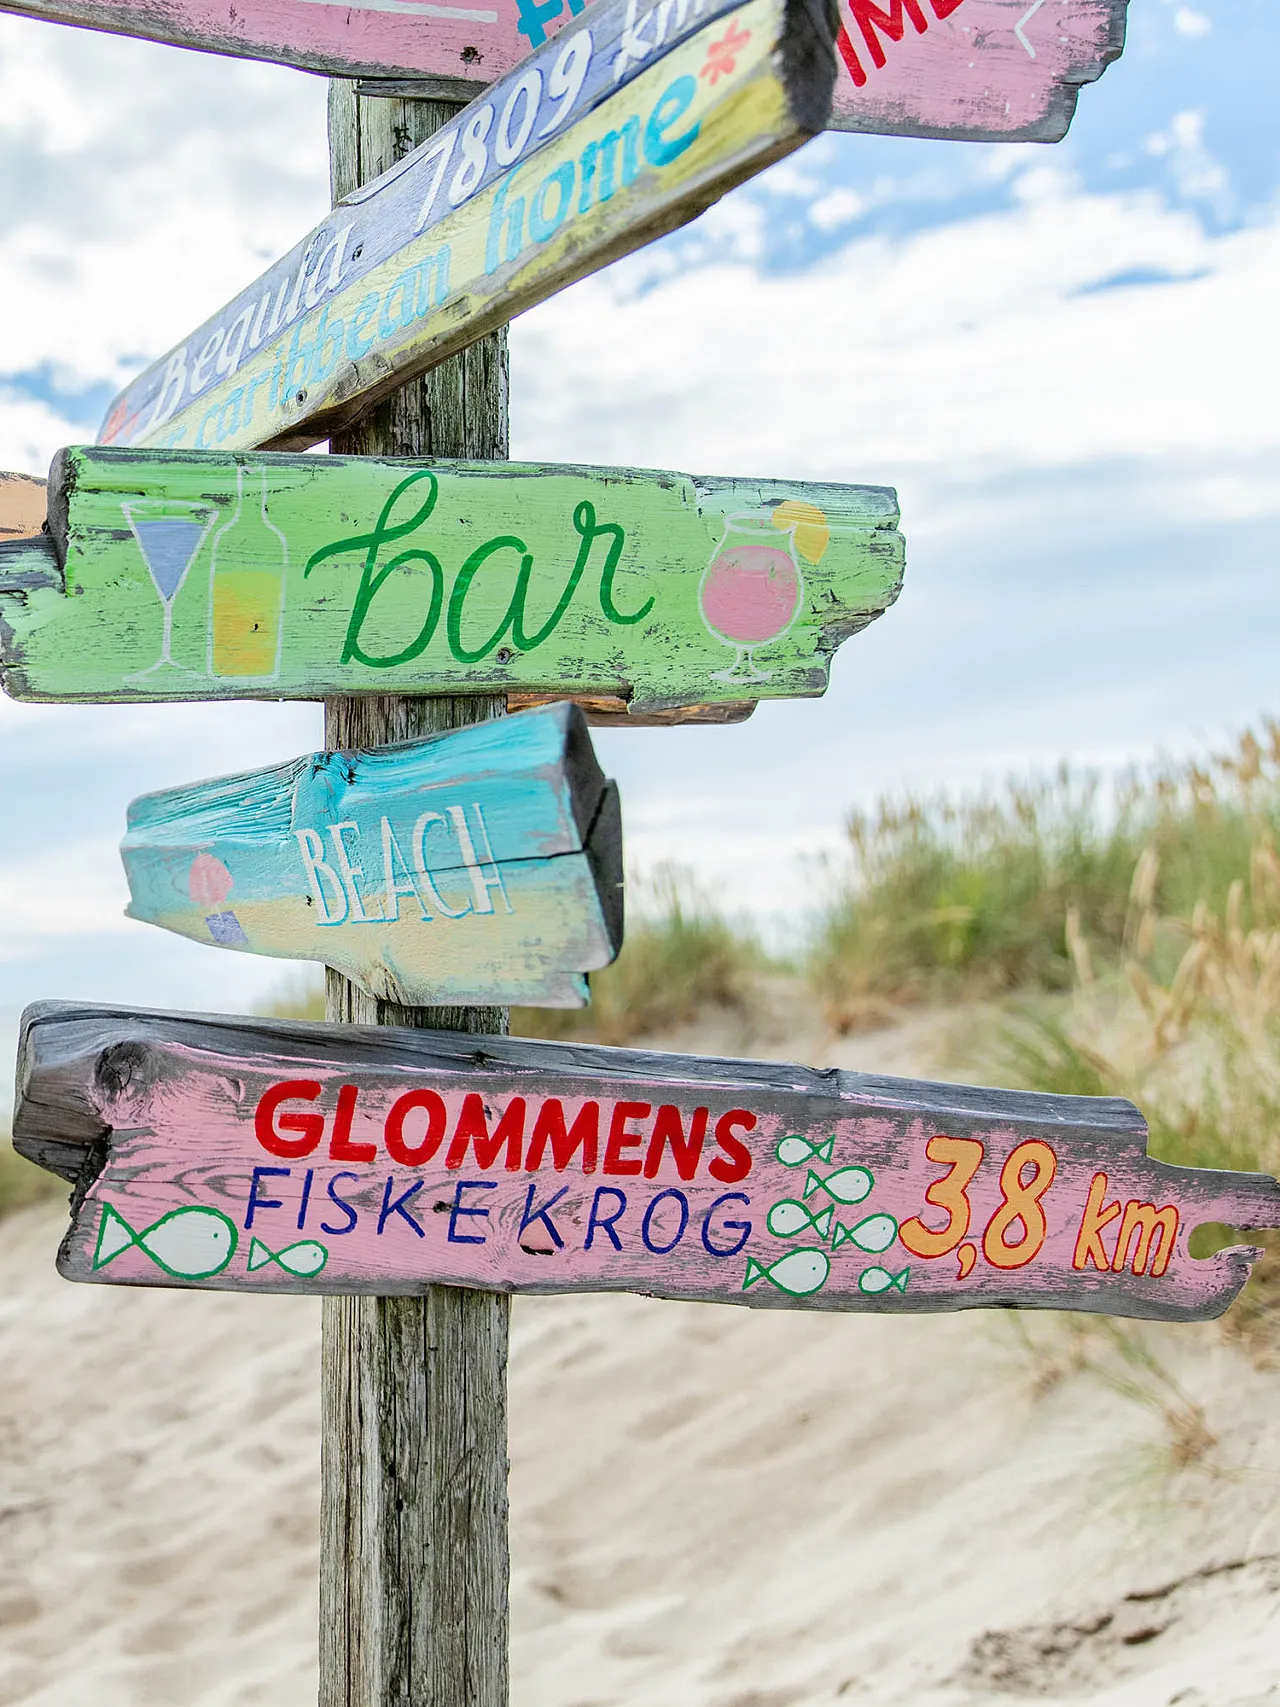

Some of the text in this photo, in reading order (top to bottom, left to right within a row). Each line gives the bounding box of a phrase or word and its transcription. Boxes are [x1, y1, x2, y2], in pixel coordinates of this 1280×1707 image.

[129, 221, 358, 447] Bequia
[413, 29, 595, 237] 7809
[194, 74, 702, 449] caribbean home
[304, 471, 655, 666] bar
[294, 802, 515, 926] BEACH
[254, 1079, 757, 1183] GLOMMENS
[899, 1135, 1180, 1281] 3,8 km
